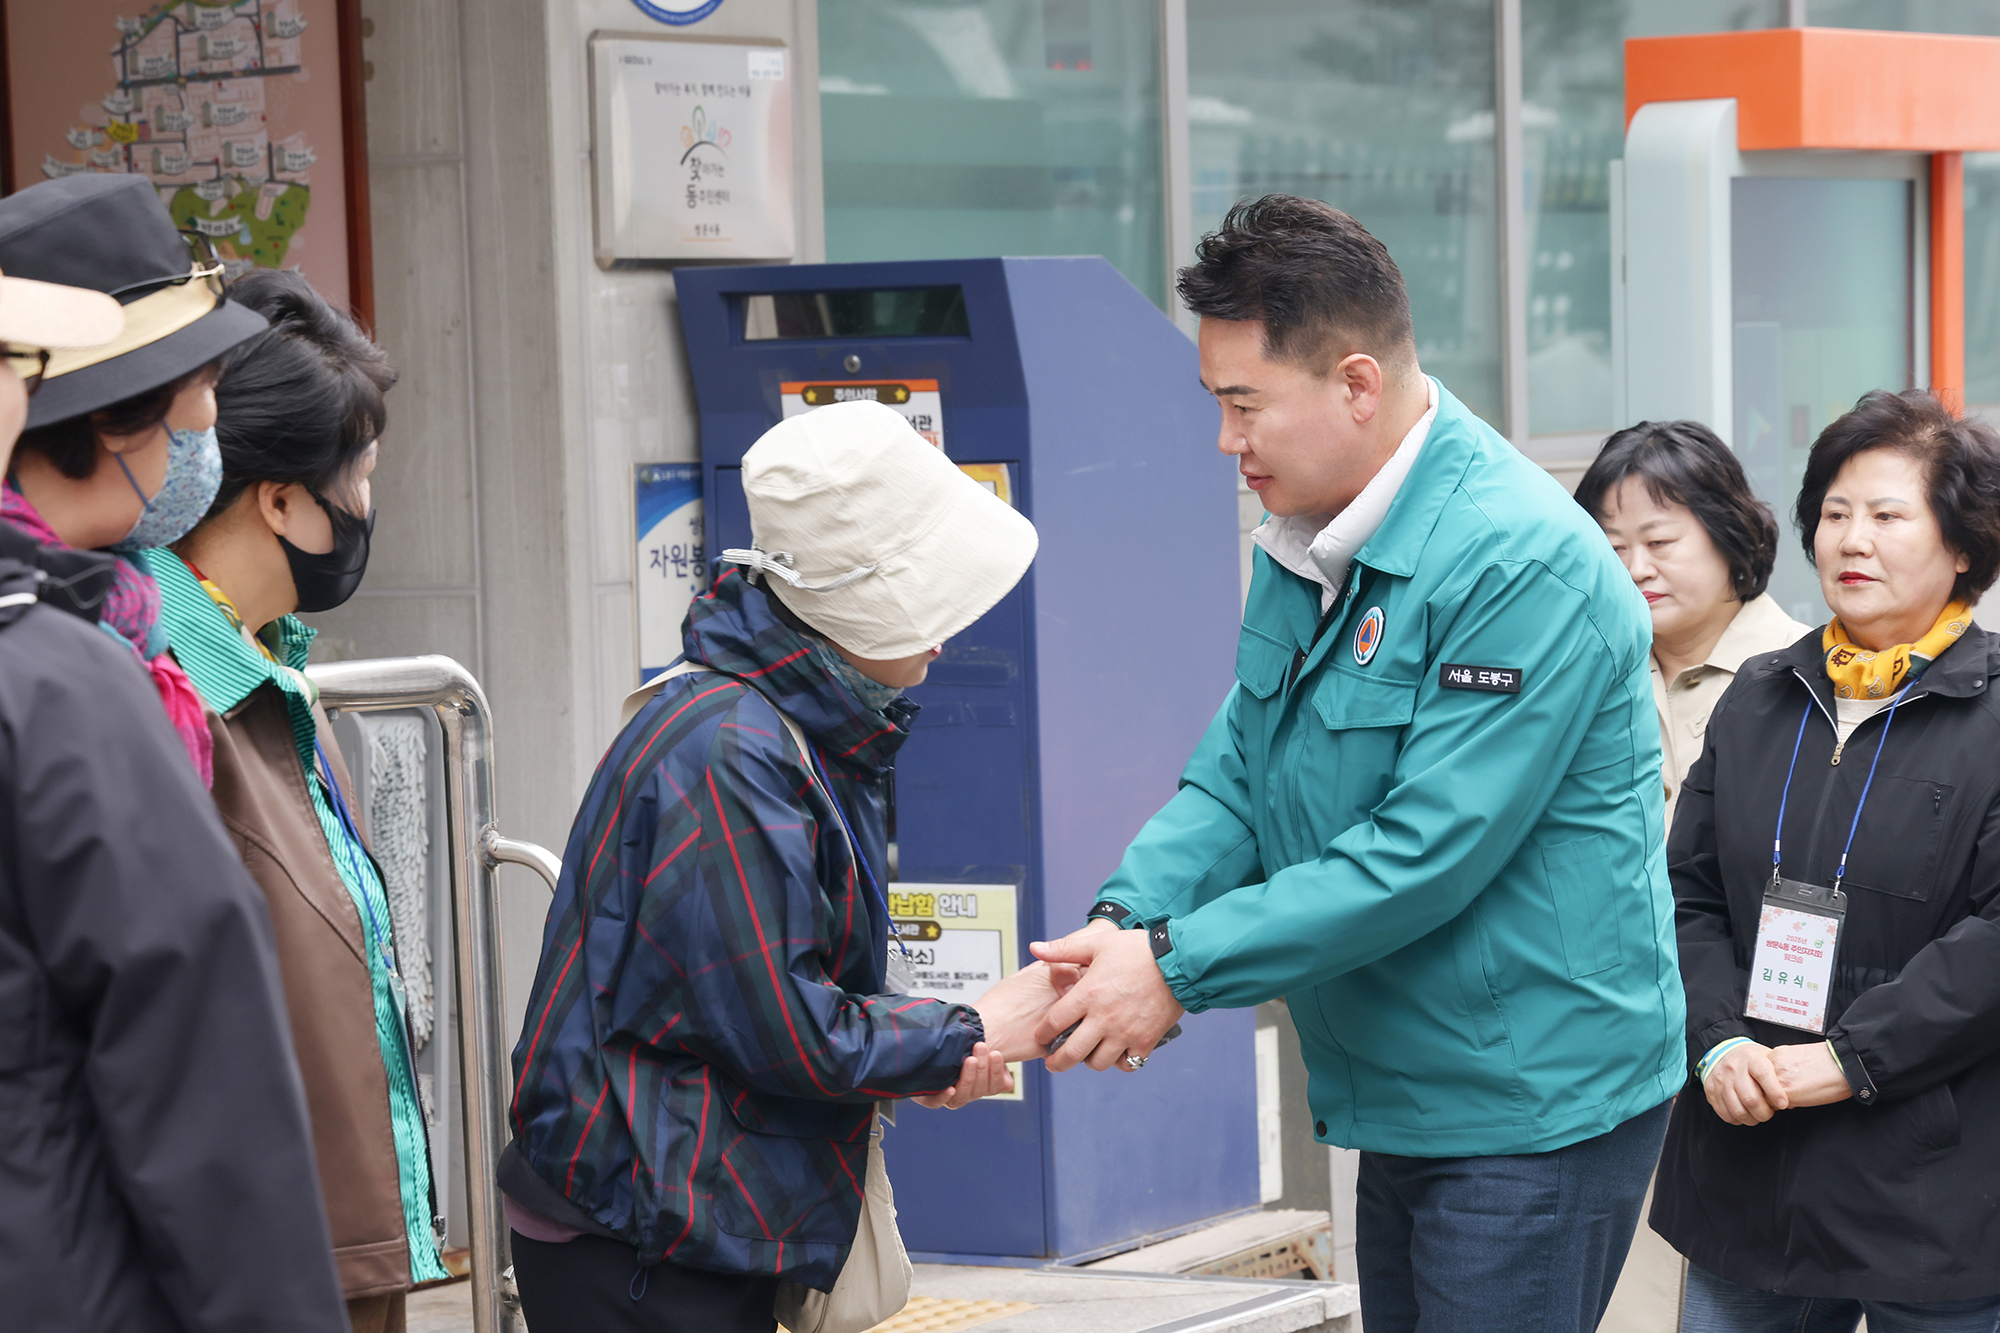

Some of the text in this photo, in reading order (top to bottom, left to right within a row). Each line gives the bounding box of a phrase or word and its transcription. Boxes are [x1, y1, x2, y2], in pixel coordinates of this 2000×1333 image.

[834, 387, 878, 401] 주의사항
[1448, 669, 1514, 687] 서울 도봉구
[938, 893, 978, 918] 안내
[1791, 944, 1823, 958] 주민자치회
